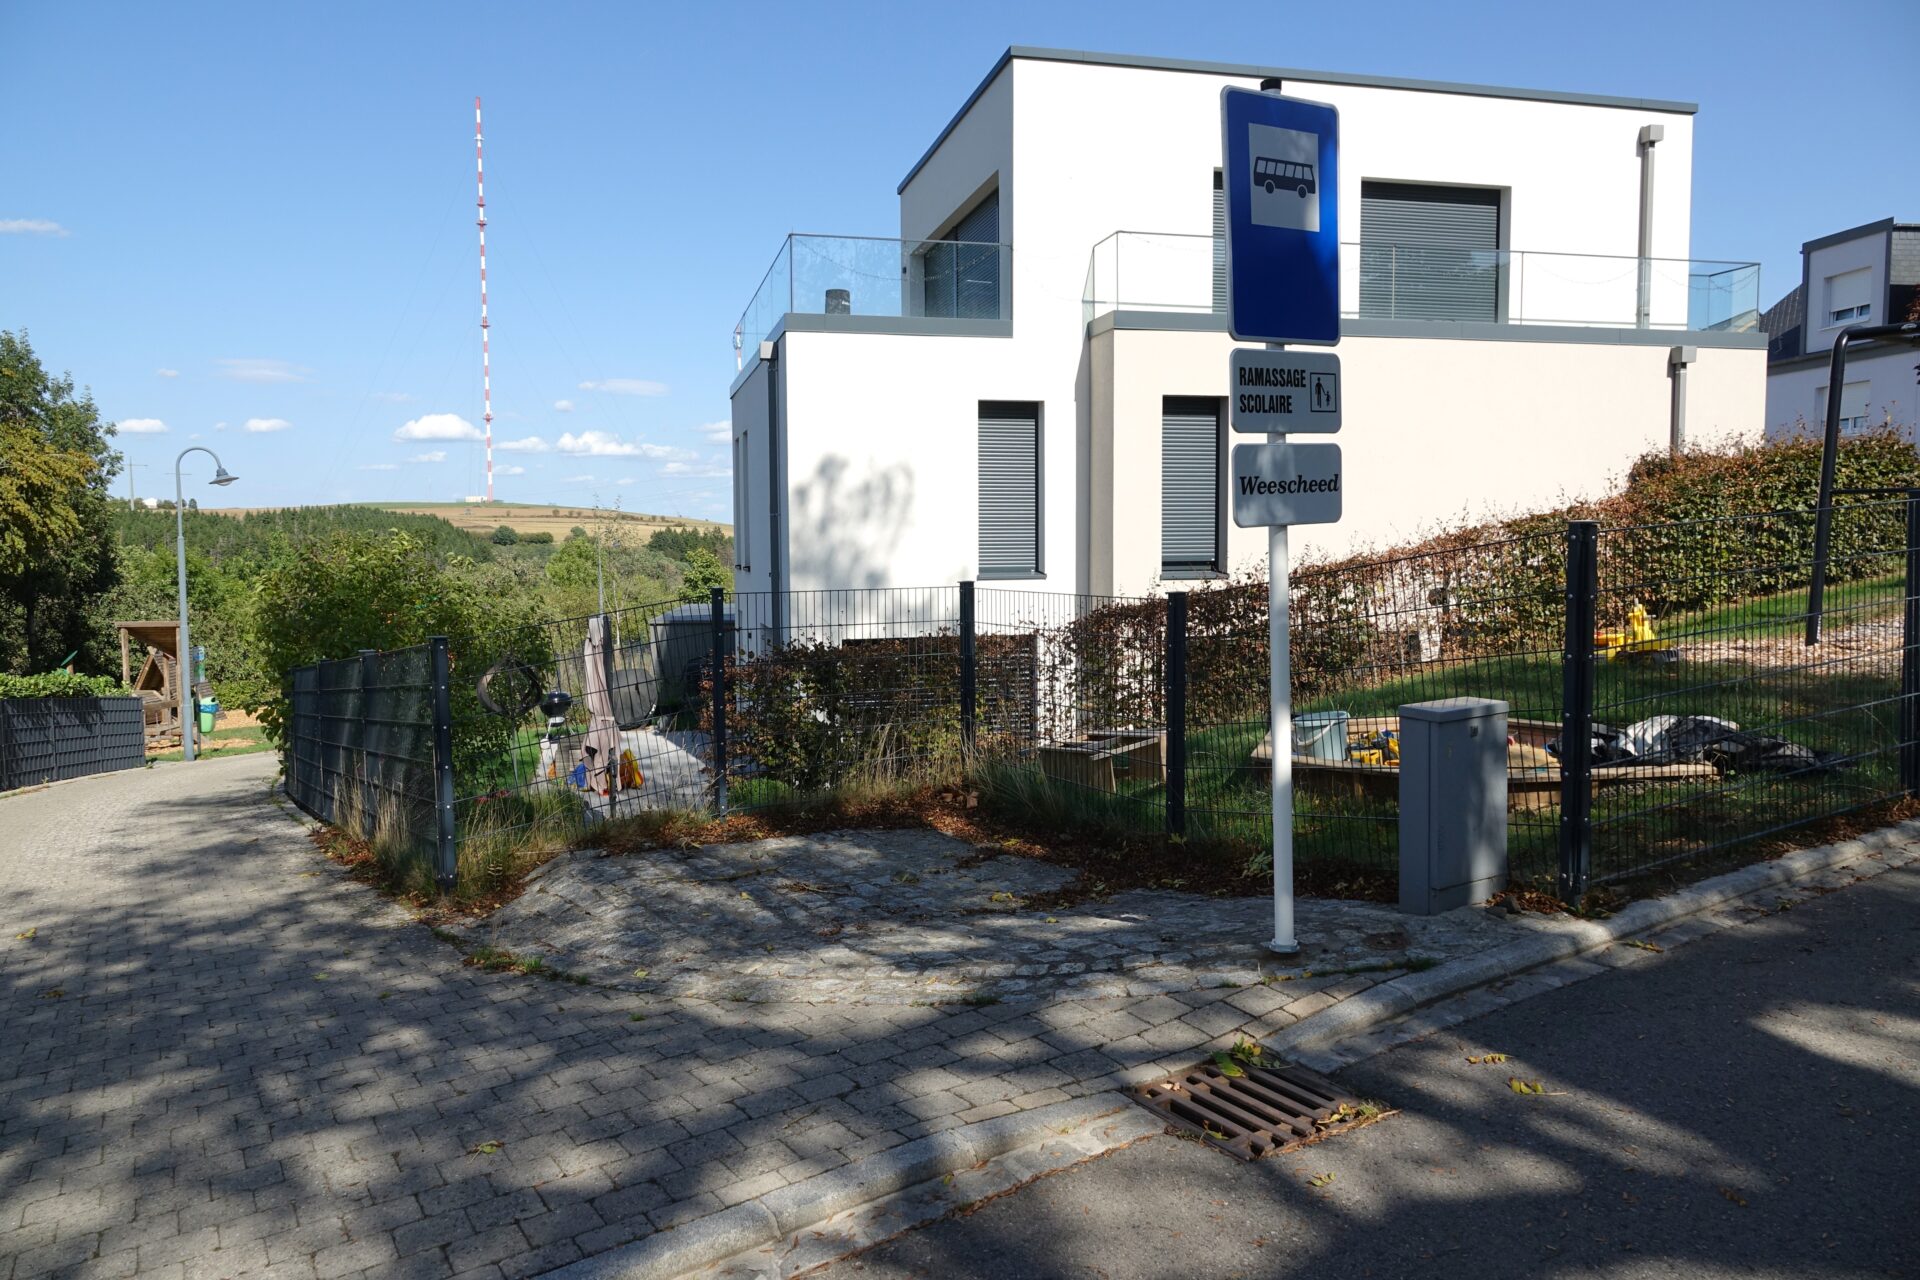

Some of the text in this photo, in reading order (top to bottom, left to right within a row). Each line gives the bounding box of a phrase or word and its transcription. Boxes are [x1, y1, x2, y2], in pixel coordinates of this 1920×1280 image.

[1239, 366, 1307, 388] RAMASSAGE
[1239, 393, 1293, 414] SCOLAIRE
[1239, 473, 1340, 495] Weescheed
